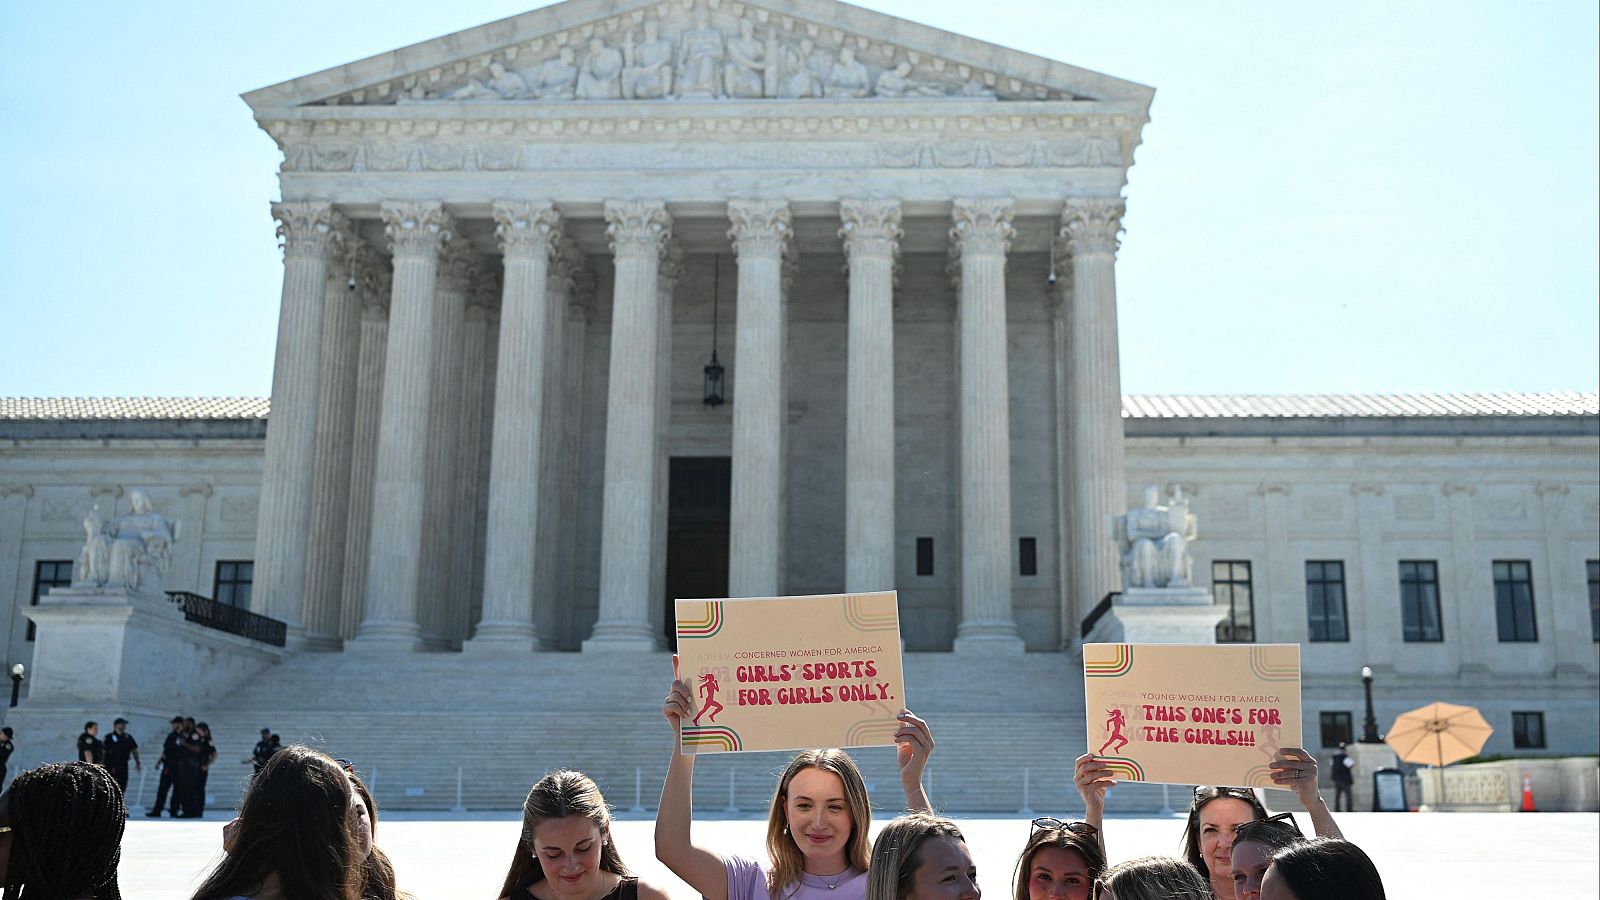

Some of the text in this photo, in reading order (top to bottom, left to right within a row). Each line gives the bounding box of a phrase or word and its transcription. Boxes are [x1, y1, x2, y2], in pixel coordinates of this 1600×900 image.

[734, 646, 883, 659] CONCERNED WOMEN FOR AMERICA
[736, 660, 877, 683] GIRLS' SPORTS
[738, 688, 772, 706] FOR
[777, 685, 834, 705] GIRLS
[838, 682, 895, 702] ONLY.
[1142, 692, 1175, 701] YOUNG
[1179, 694, 1216, 702] WOMEN
[1219, 695, 1237, 703] FOR
[1239, 695, 1280, 703] AMERICA
[1142, 704, 1187, 722] THIS
[1191, 706, 1243, 724] ONE'S
[1248, 708, 1282, 725] FOR
[1142, 726, 1179, 743] THE
[1184, 728, 1256, 747] GIRLS!!!
